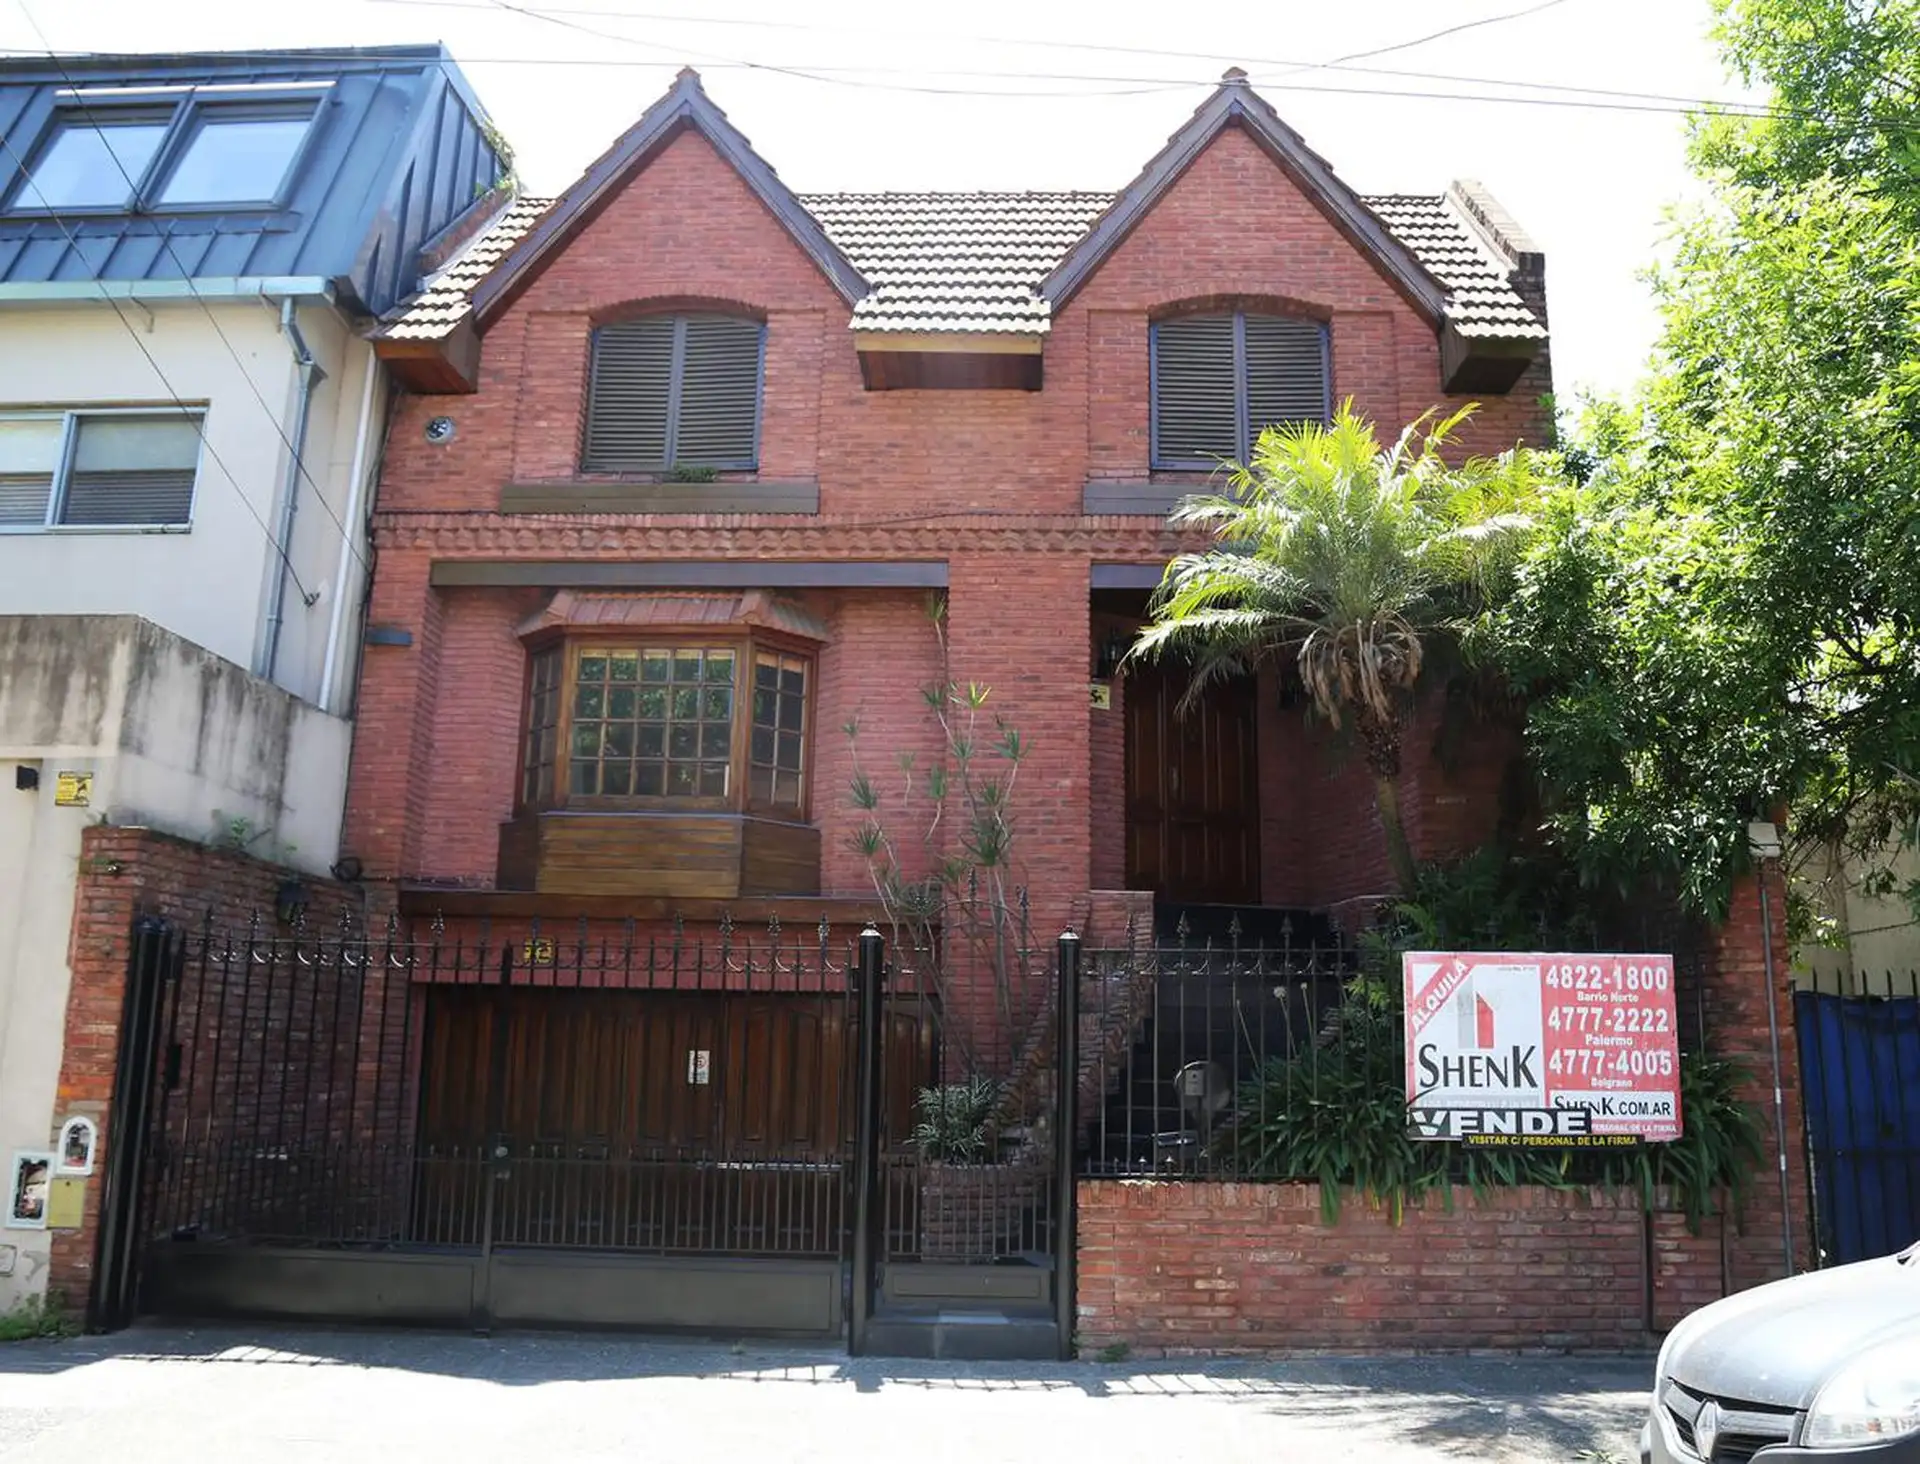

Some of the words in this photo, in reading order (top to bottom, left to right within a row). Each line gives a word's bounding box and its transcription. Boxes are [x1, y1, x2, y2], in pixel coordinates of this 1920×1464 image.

[1545, 964, 1668, 990] 4822-1800
[1411, 959, 1469, 1033] ALQUILA
[1576, 991, 1609, 1002] Barrio
[1610, 991, 1640, 1003] Norte
[1548, 1006, 1669, 1032] 4777-2222
[1585, 1034, 1634, 1046] Palermo
[1548, 1048, 1673, 1076] 4777-4005
[1591, 1077, 1633, 1090] Belgrano
[1411, 1109, 1588, 1136] VENDE
[1468, 1135, 1509, 1145] VISITAR
[1522, 1136, 1575, 1147] PERSONAL
[1578, 1137, 1591, 1146] DE
[1592, 1136, 1606, 1146] LA
[1607, 1136, 1638, 1146] FIRMA
